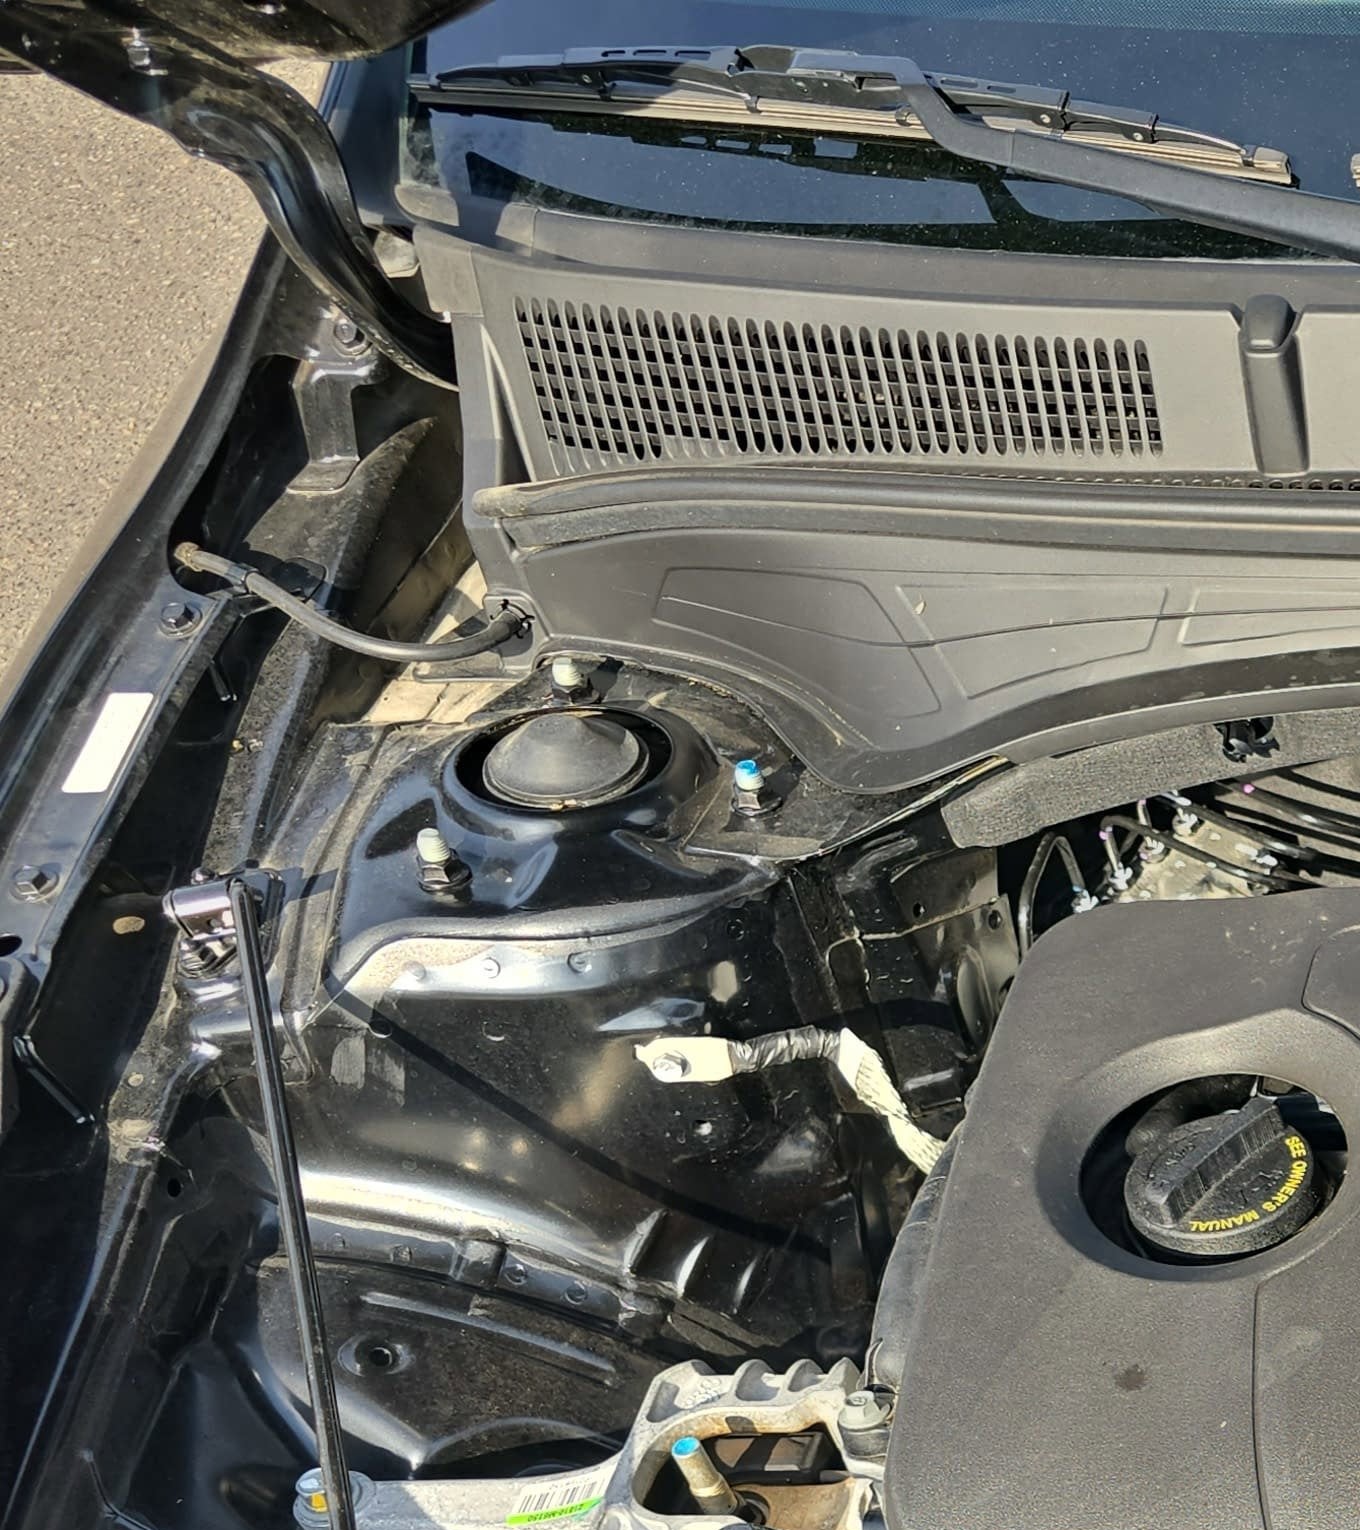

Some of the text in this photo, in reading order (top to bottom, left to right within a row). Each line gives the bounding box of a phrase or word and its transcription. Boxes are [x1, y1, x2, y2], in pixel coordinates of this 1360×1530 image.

[1189, 1135, 1308, 1232] SEE OWNER'S MANUAL
